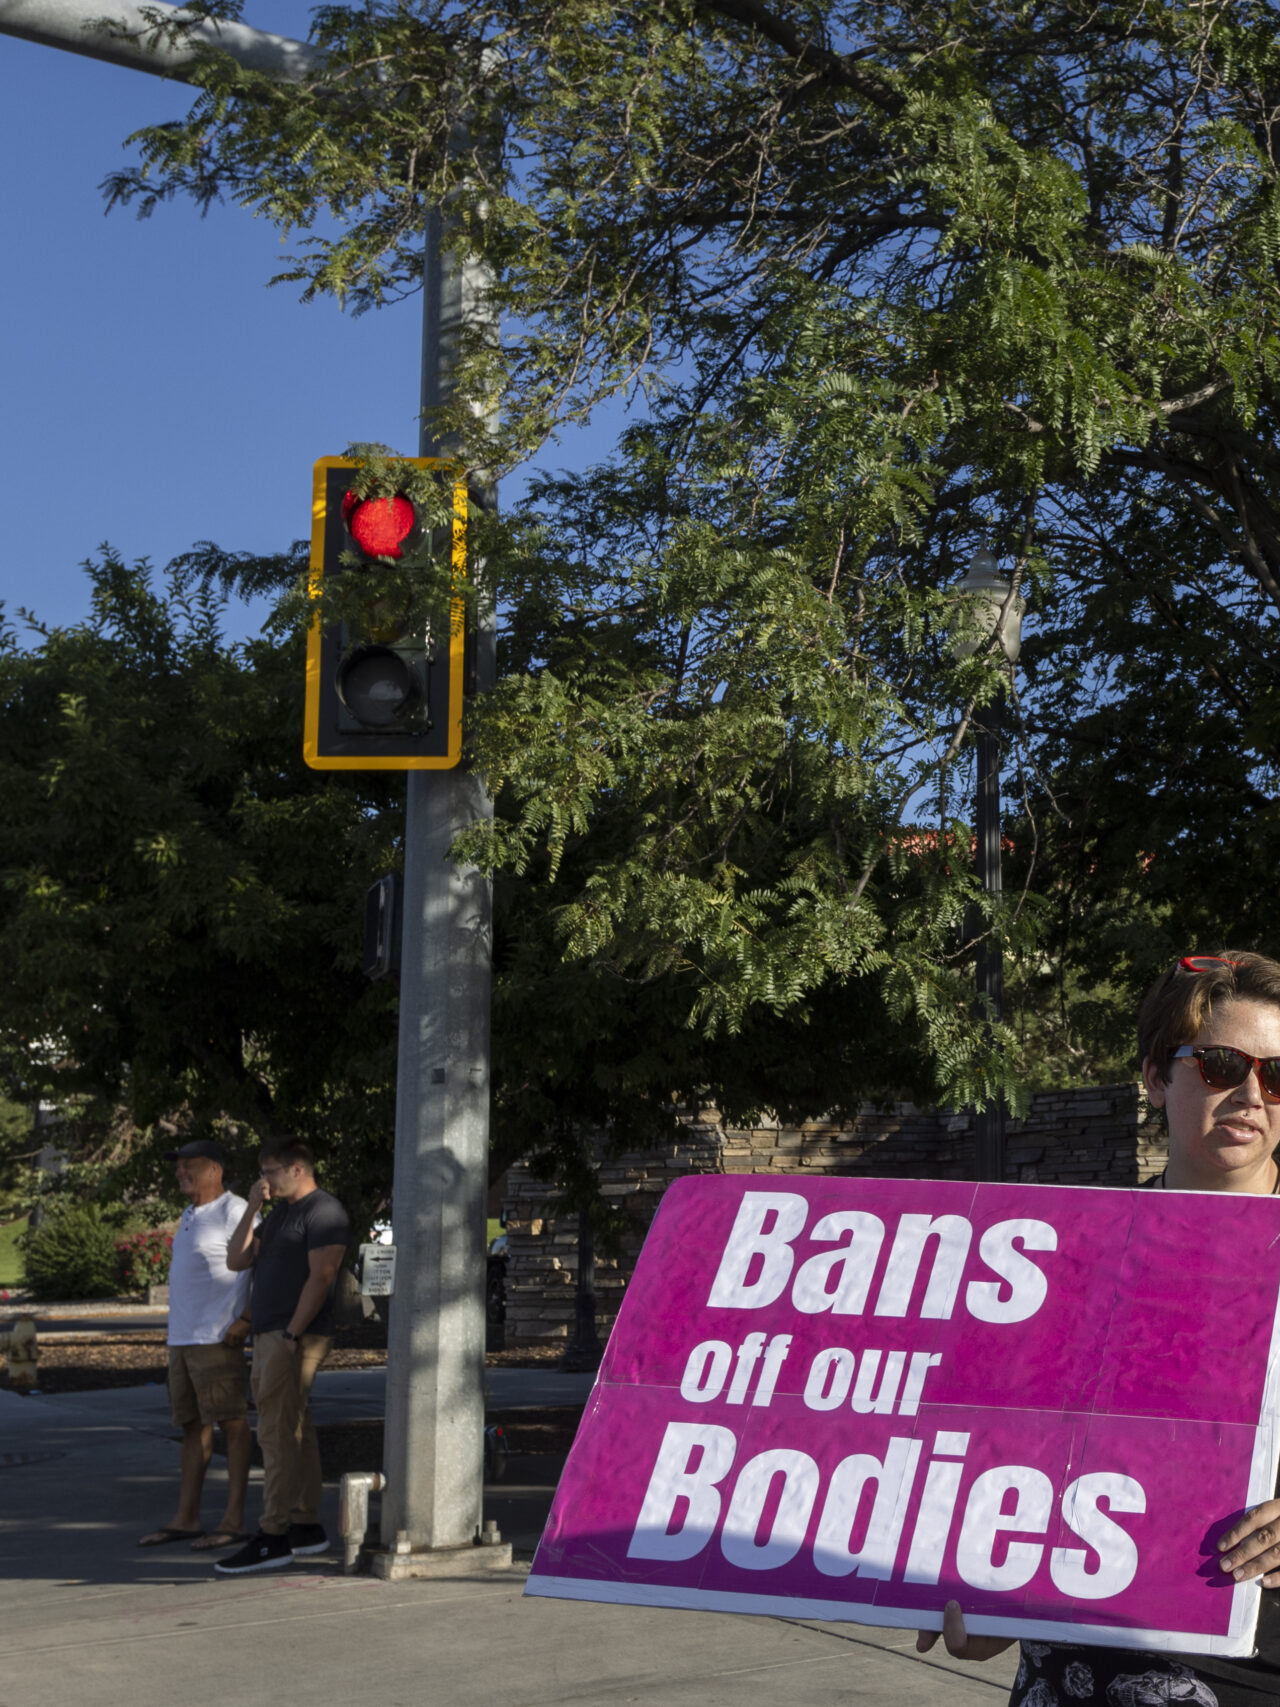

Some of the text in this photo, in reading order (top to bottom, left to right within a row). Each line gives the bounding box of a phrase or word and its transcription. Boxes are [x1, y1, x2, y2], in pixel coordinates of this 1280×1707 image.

[706, 1190, 1059, 1325] Bans
[680, 1331, 942, 1417] off our
[626, 1421, 1148, 1600] Bodies
